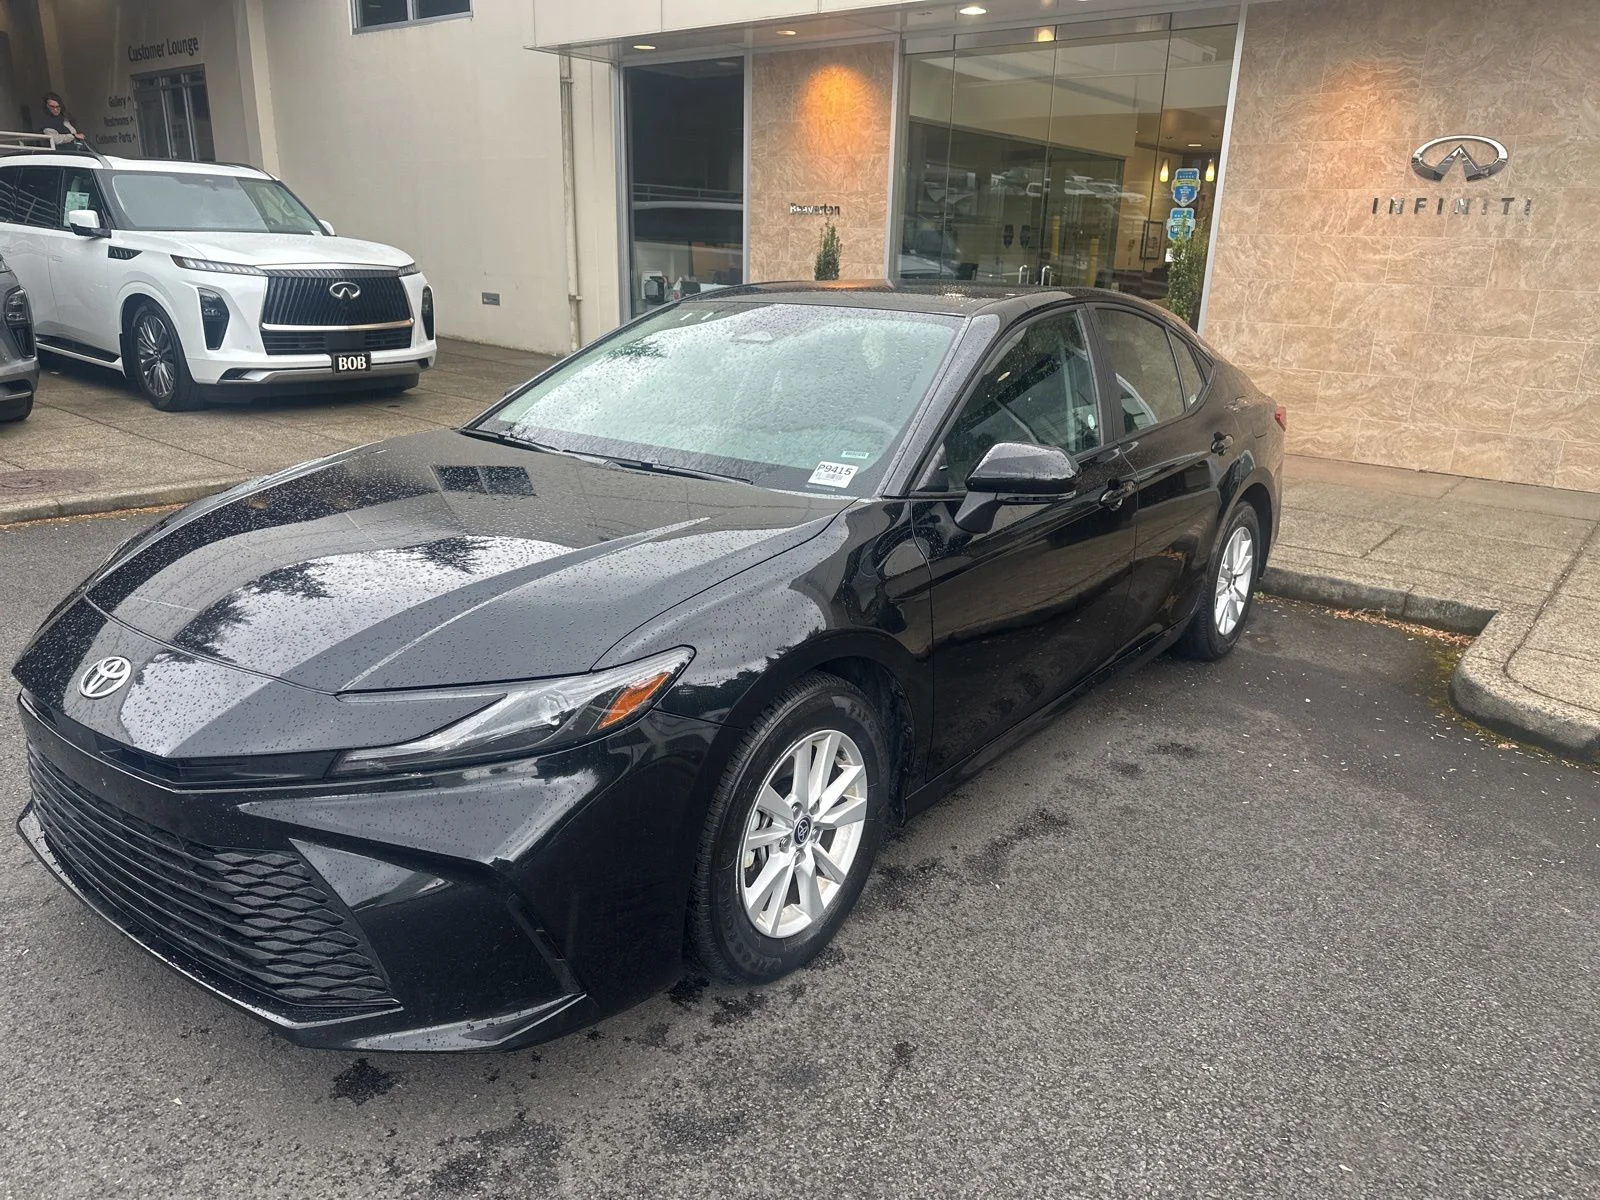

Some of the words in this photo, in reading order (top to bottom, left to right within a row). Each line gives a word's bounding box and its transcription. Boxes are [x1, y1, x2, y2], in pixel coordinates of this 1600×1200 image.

[128, 43, 165, 62] Customer
[166, 37, 199, 56] Lounge
[789, 202, 840, 216] Beaverton
[1371, 196, 1533, 216] INFINITI
[338, 355, 367, 371] BOB
[816, 463, 854, 476] P9415
